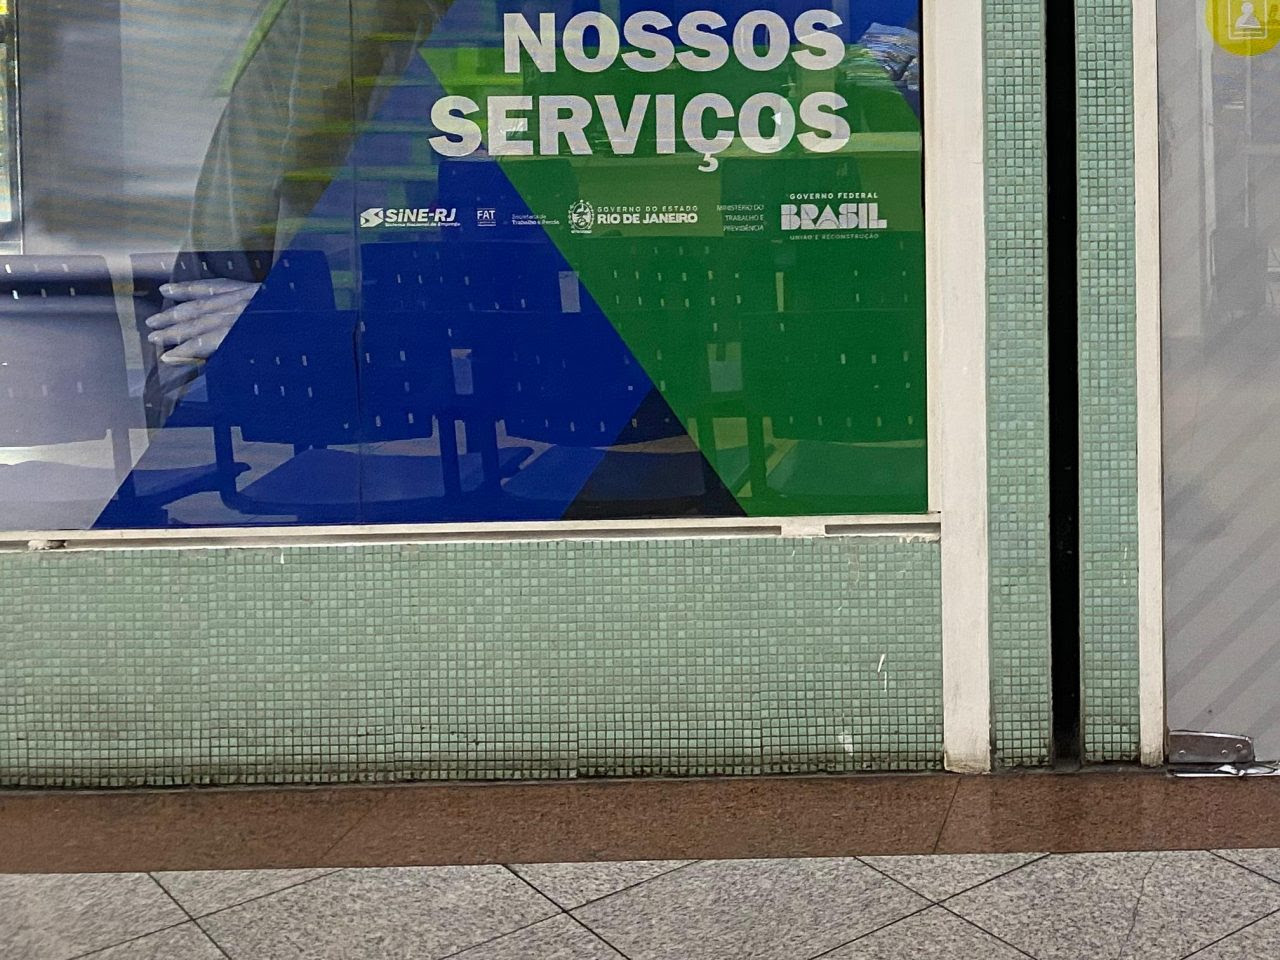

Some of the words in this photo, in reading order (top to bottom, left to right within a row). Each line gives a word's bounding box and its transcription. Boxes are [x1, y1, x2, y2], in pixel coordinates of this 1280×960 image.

[503, 9, 846, 73] NOSSOS
[428, 91, 851, 173] SERVIÇOS
[477, 210, 496, 220] FAT
[597, 214, 622, 225] RIO
[623, 214, 641, 224] DE
[643, 212, 698, 224] JANEIRO
[781, 203, 888, 231] BRASIL
